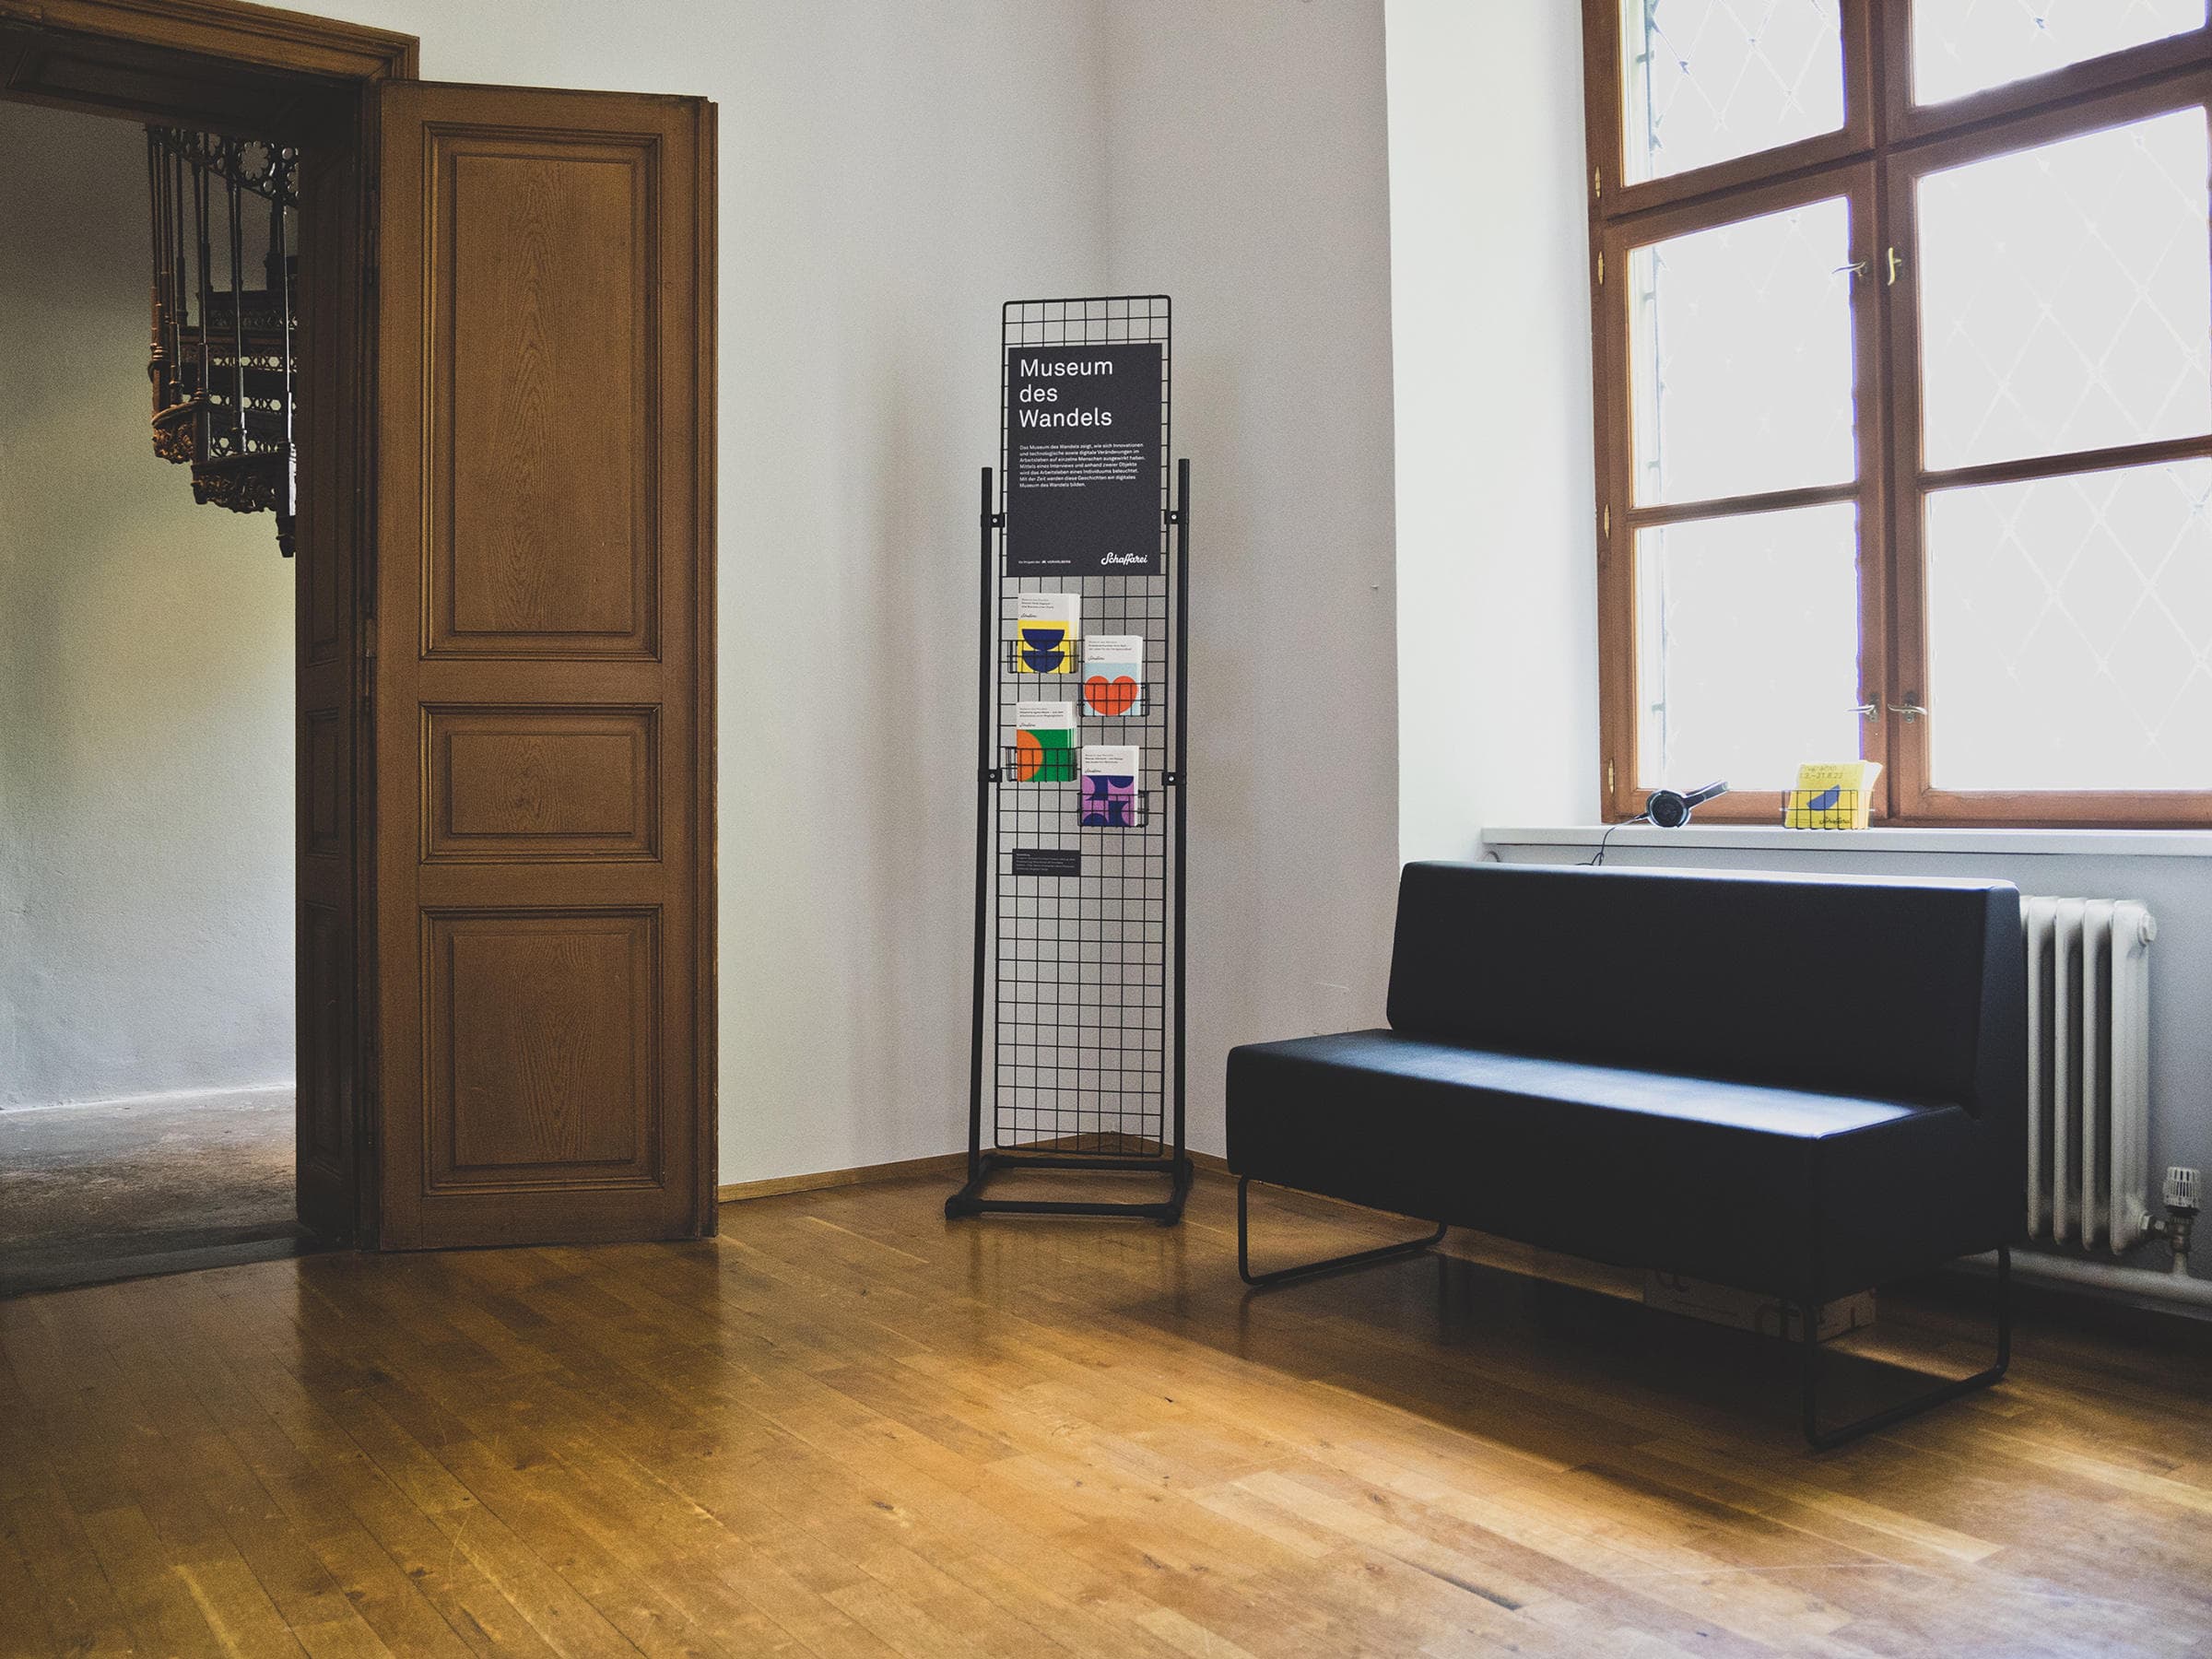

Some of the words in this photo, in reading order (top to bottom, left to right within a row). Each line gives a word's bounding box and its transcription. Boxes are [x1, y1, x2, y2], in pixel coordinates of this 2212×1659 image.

[1019, 359, 1113, 378] Museum
[1019, 383, 1058, 403] des
[1018, 406, 1112, 428] Wandels
[1100, 551, 1148, 566] Schaffarei
